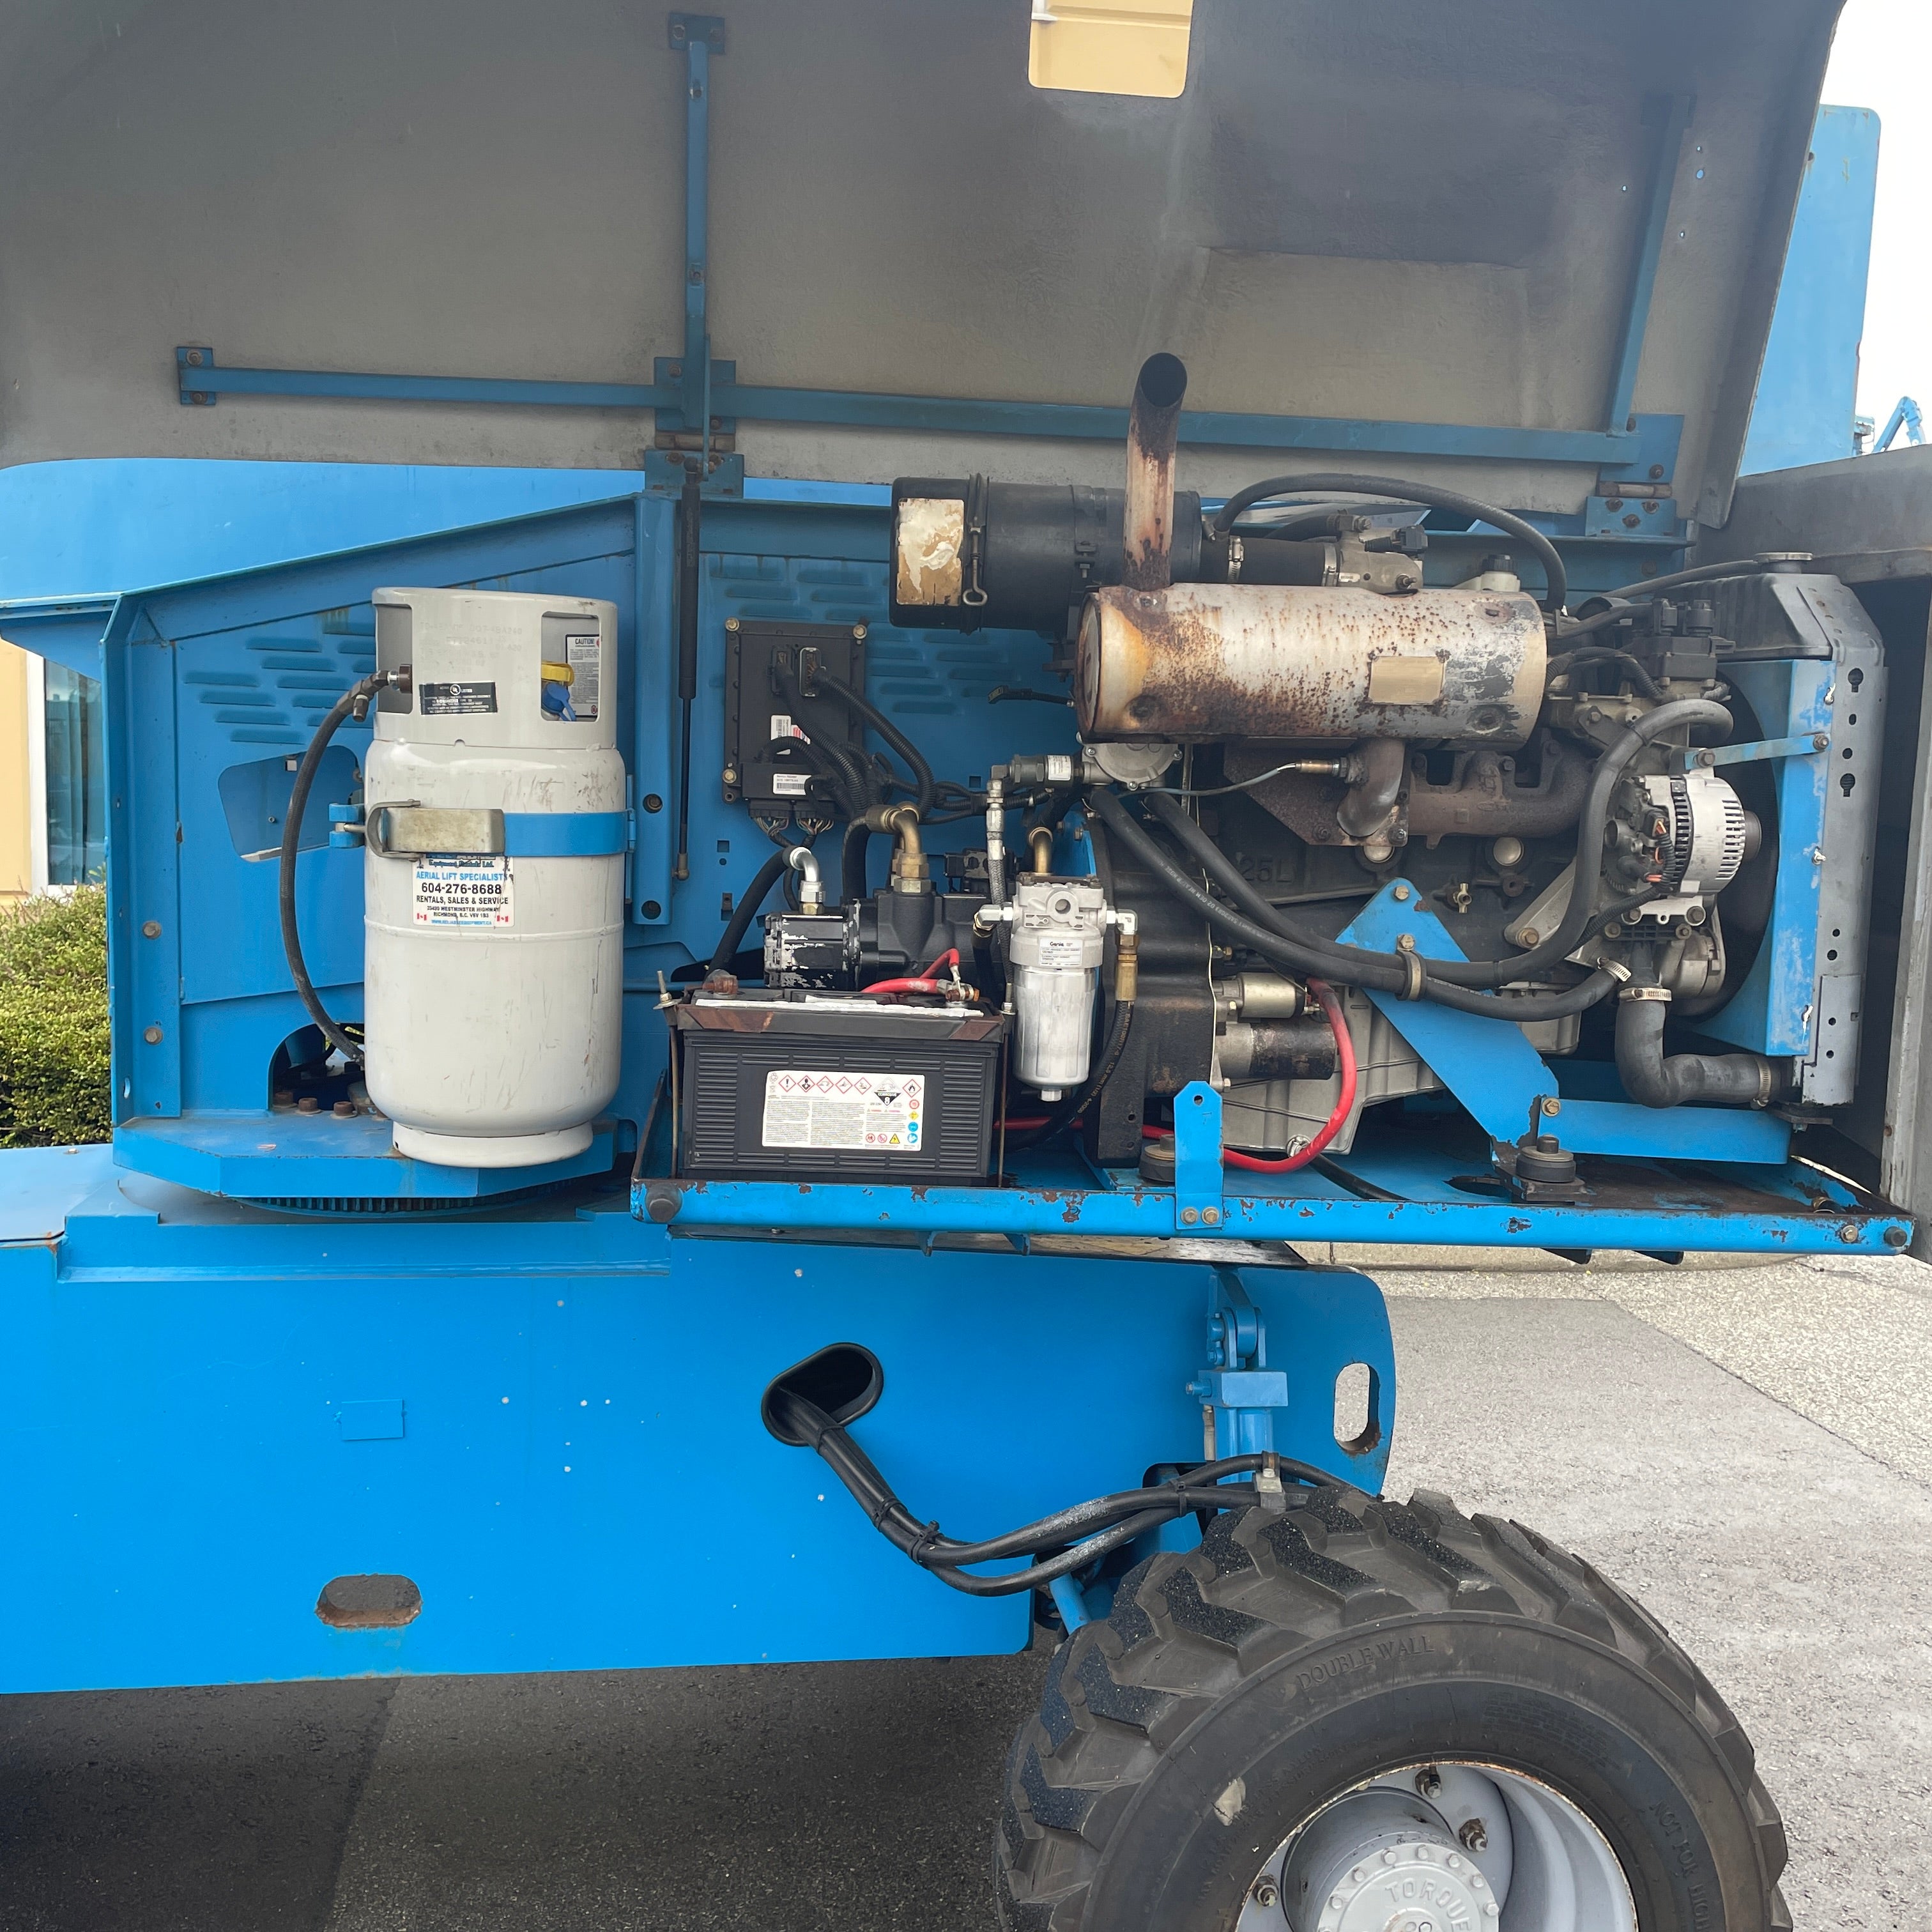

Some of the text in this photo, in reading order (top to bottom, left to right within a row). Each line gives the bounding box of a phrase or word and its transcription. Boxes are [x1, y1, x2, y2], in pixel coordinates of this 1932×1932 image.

[416, 895, 446, 905] RENTALS,
[422, 882, 502, 894] 604-276-8688
[1296, 1636, 1435, 1691] DOUBLE WALL
[1649, 1800, 1682, 1836] NOT
[1671, 1839, 1699, 1878] FOR
[1385, 1878, 1471, 1931] TORQUE
